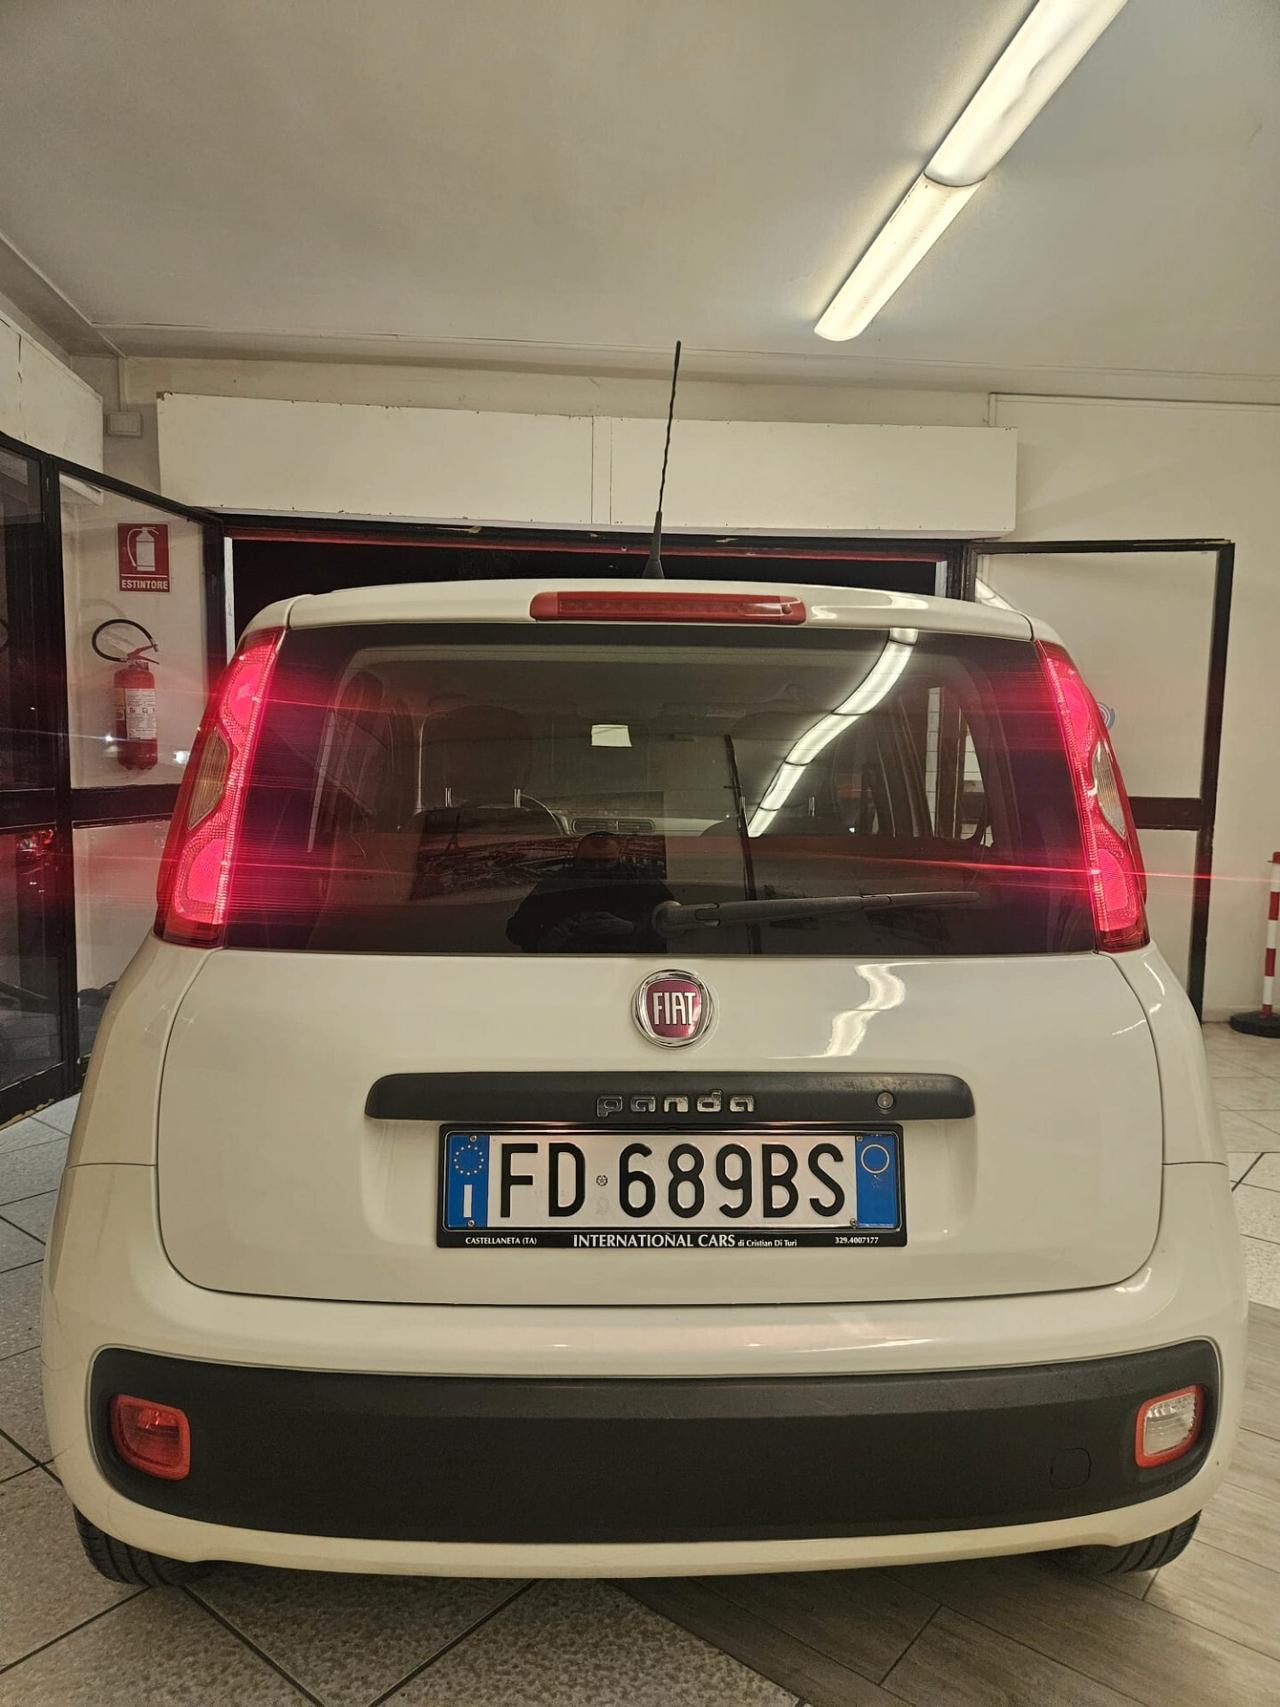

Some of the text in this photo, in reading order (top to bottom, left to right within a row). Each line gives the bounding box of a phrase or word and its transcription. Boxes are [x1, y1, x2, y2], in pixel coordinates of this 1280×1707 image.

[121, 580, 168, 590] ESTINTORE
[653, 991, 696, 1025] FIAT
[597, 1089, 755, 1117] panda
[500, 1142, 846, 1218] FD 689BS
[465, 1236, 538, 1246] CASTELLANETA (TA)
[573, 1234, 798, 1248] INTERNATIONAL CARS di Cristian Di Turi
[834, 1236, 880, 1245] 329.4007177
